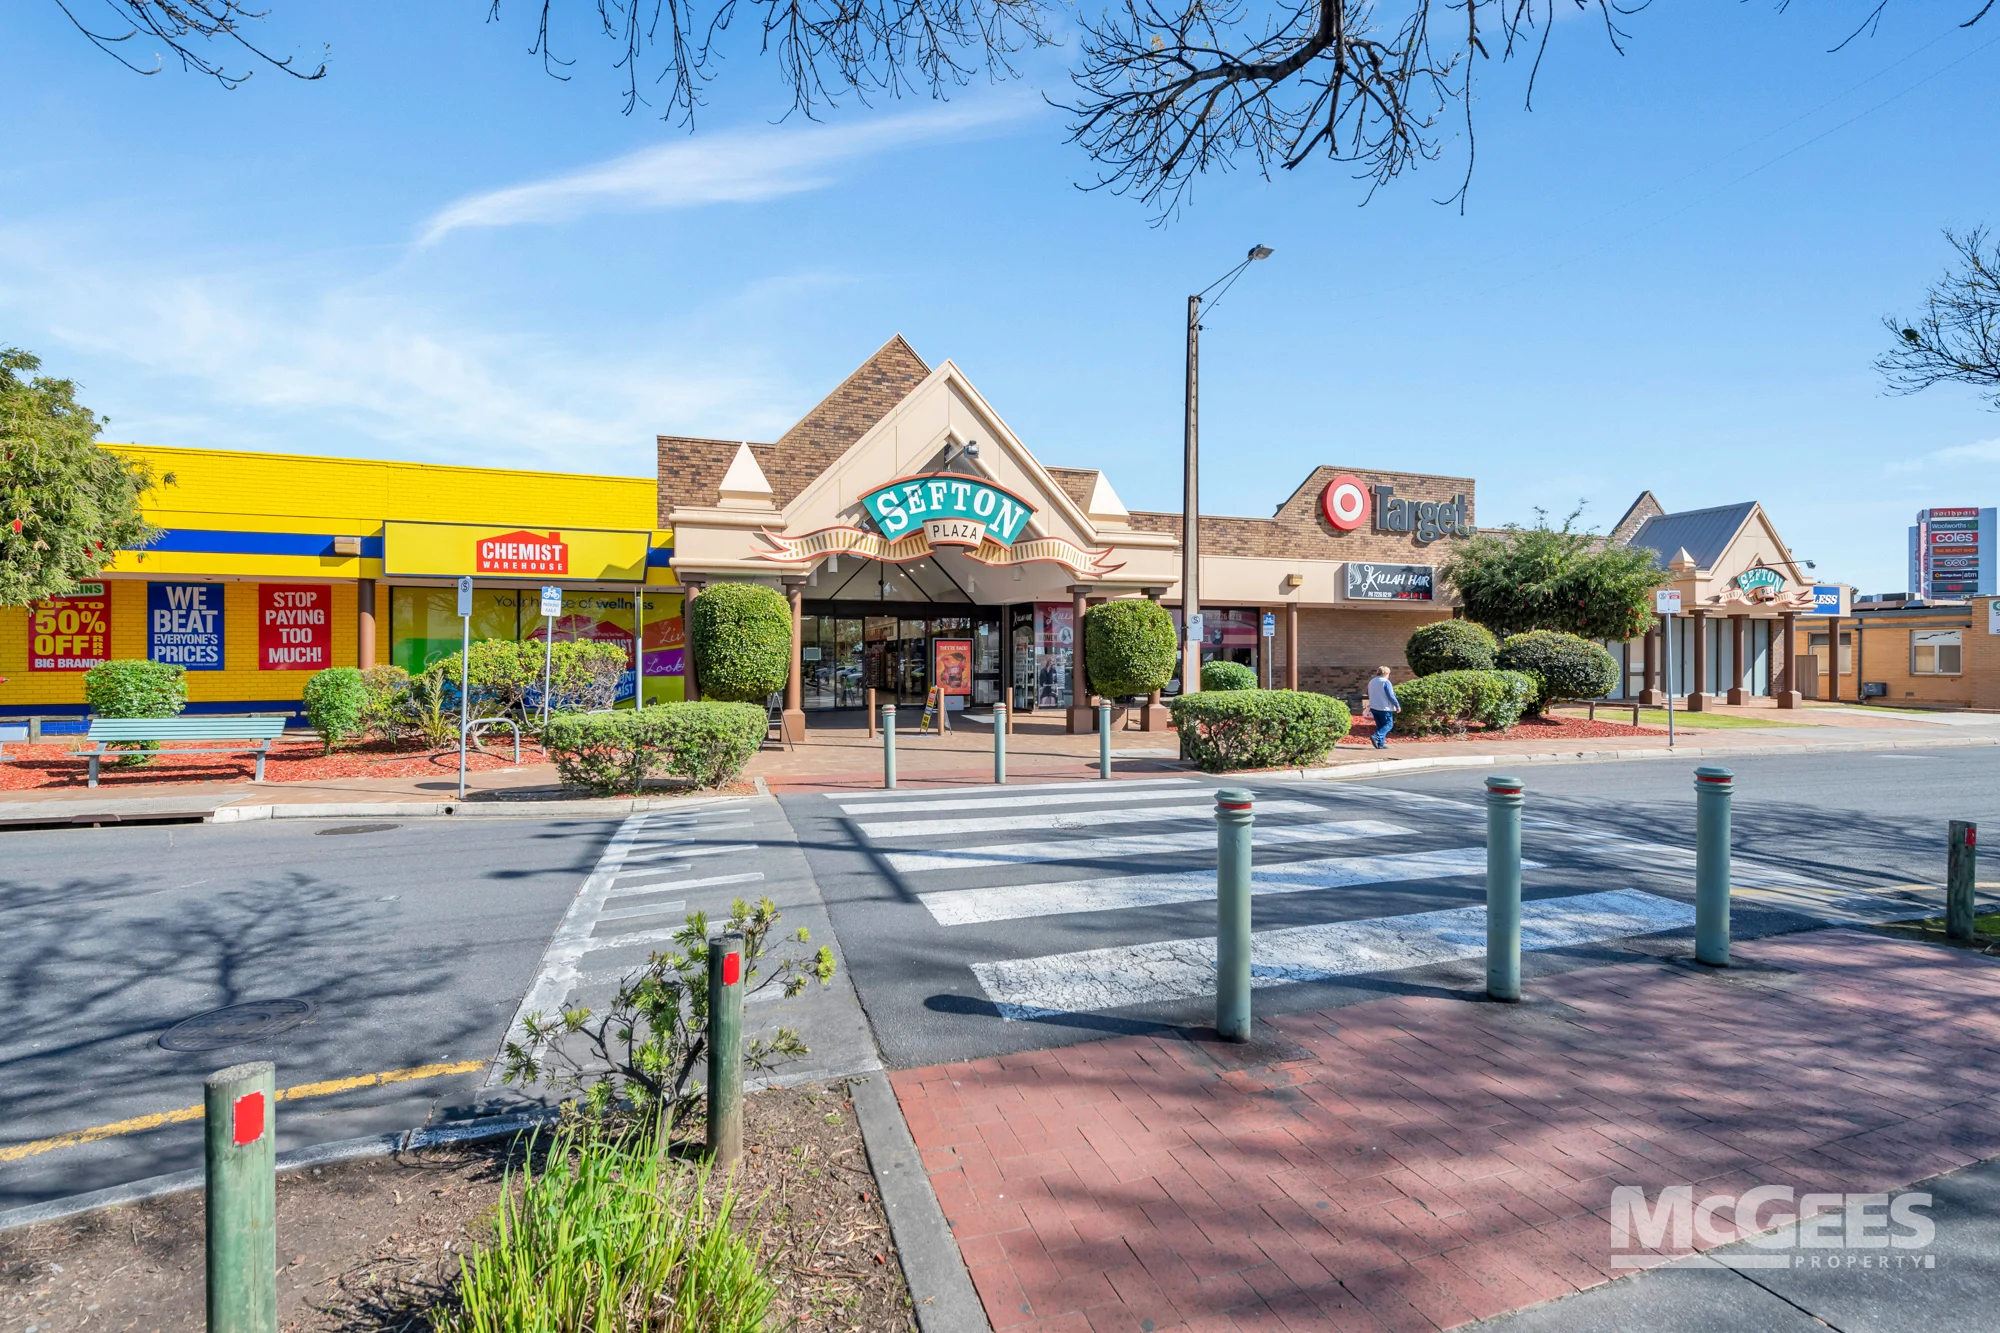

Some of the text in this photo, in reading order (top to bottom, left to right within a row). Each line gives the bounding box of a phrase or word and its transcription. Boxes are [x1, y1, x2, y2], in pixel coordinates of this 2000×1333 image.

[877, 482, 1024, 539] SEFTON
[933, 524, 978, 539] PLAZA
[1936, 532, 1973, 543] coles
[482, 542, 563, 561] CHEMIST
[483, 561, 563, 571] WAREHOUSE
[1364, 566, 1430, 591] KILLAH HAIR
[1741, 568, 1783, 592] SEFTON
[38, 601, 105, 609] UP TO
[165, 586, 207, 610] WE
[273, 591, 317, 607] STOP
[493, 594, 654, 610] Your hse of wellnss
[1813, 594, 1838, 605] LESS
[35, 609, 106, 634] 50%
[153, 609, 218, 633] BEAT
[265, 609, 325, 626] PAYING
[154, 633, 218, 645] EVERYONE'S
[279, 628, 312, 644] TOO
[34, 634, 90, 656] OFF
[154, 645, 219, 662] PRICES
[34, 658, 55, 669] BIG
[268, 646, 322, 664] MUCH!
